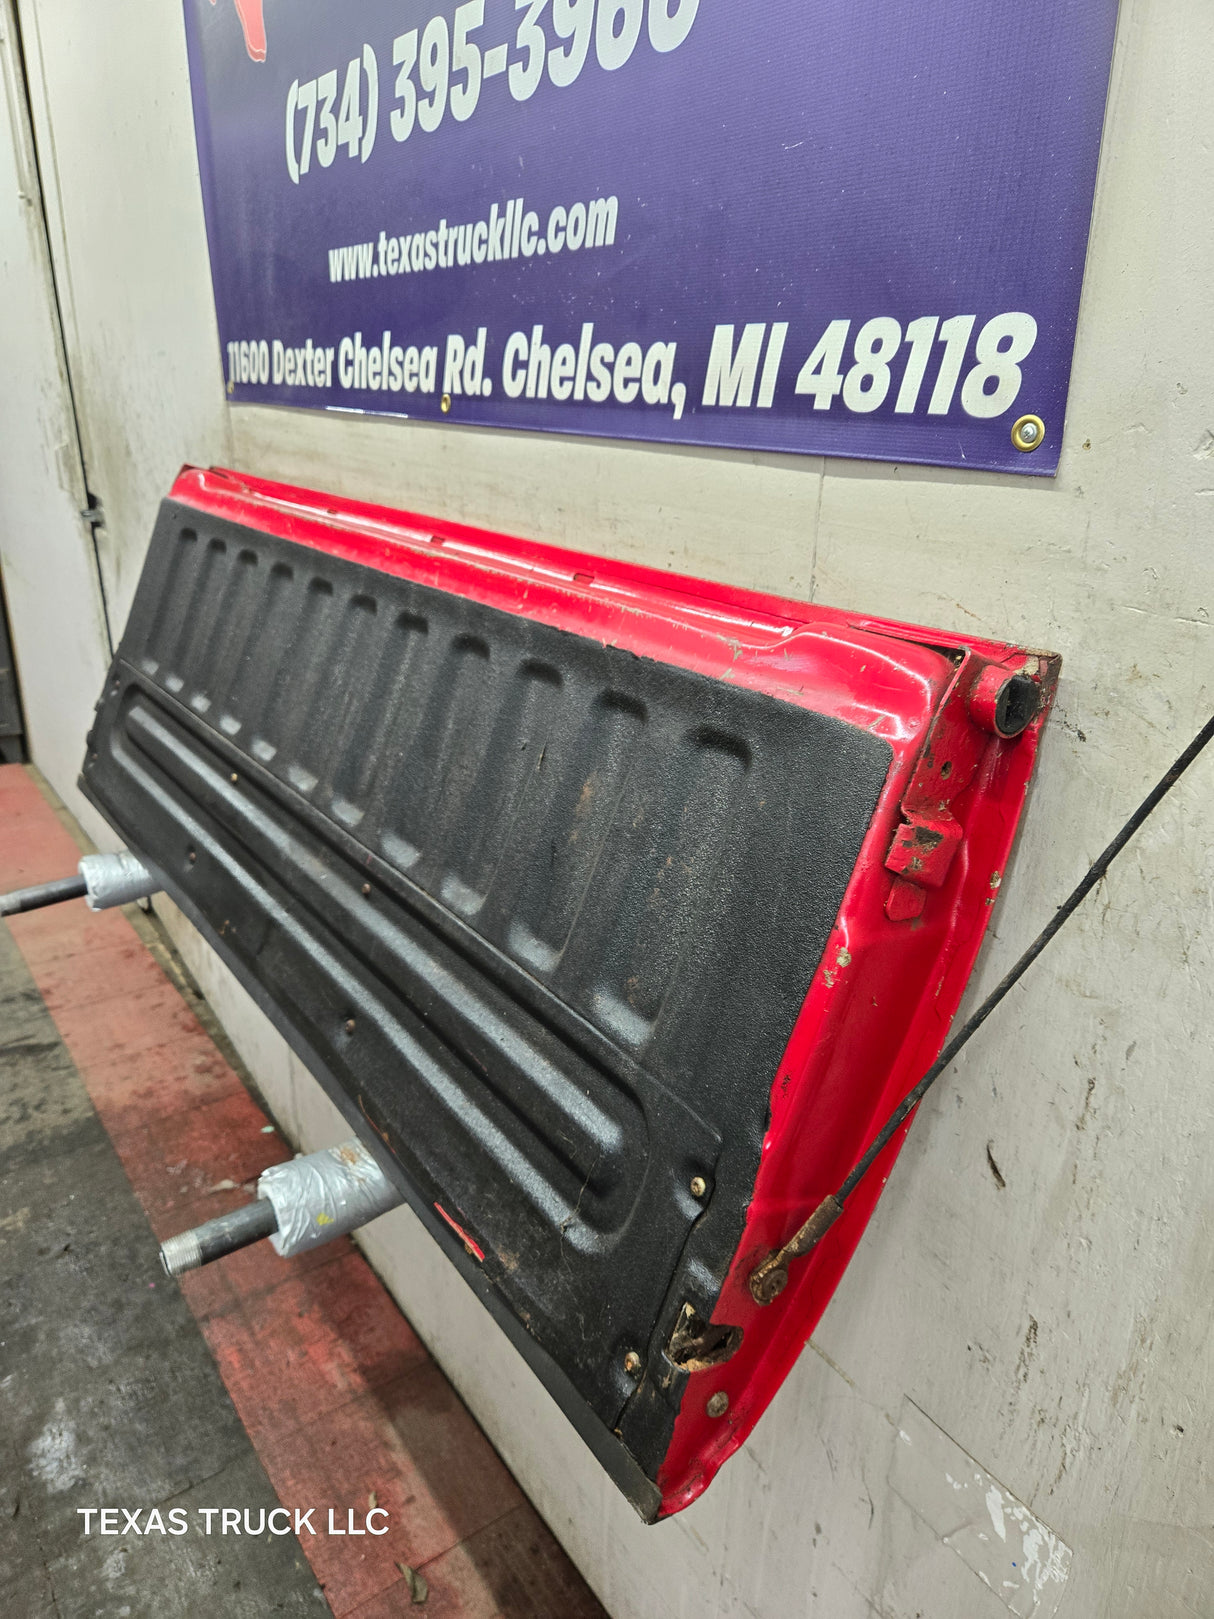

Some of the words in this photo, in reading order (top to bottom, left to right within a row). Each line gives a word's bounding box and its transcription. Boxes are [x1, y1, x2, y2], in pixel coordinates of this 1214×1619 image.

[286, 43, 378, 184] (734)
[328, 195, 619, 282] www.texastruckllc.com
[227, 340, 269, 385] 11600
[272, 338, 334, 387] Dexter
[338, 330, 439, 393] Chelsea
[442, 327, 493, 397] Rd.
[502, 322, 686, 420] Chelsea,
[702, 322, 789, 408] MI
[794, 311, 1038, 419] 48118
